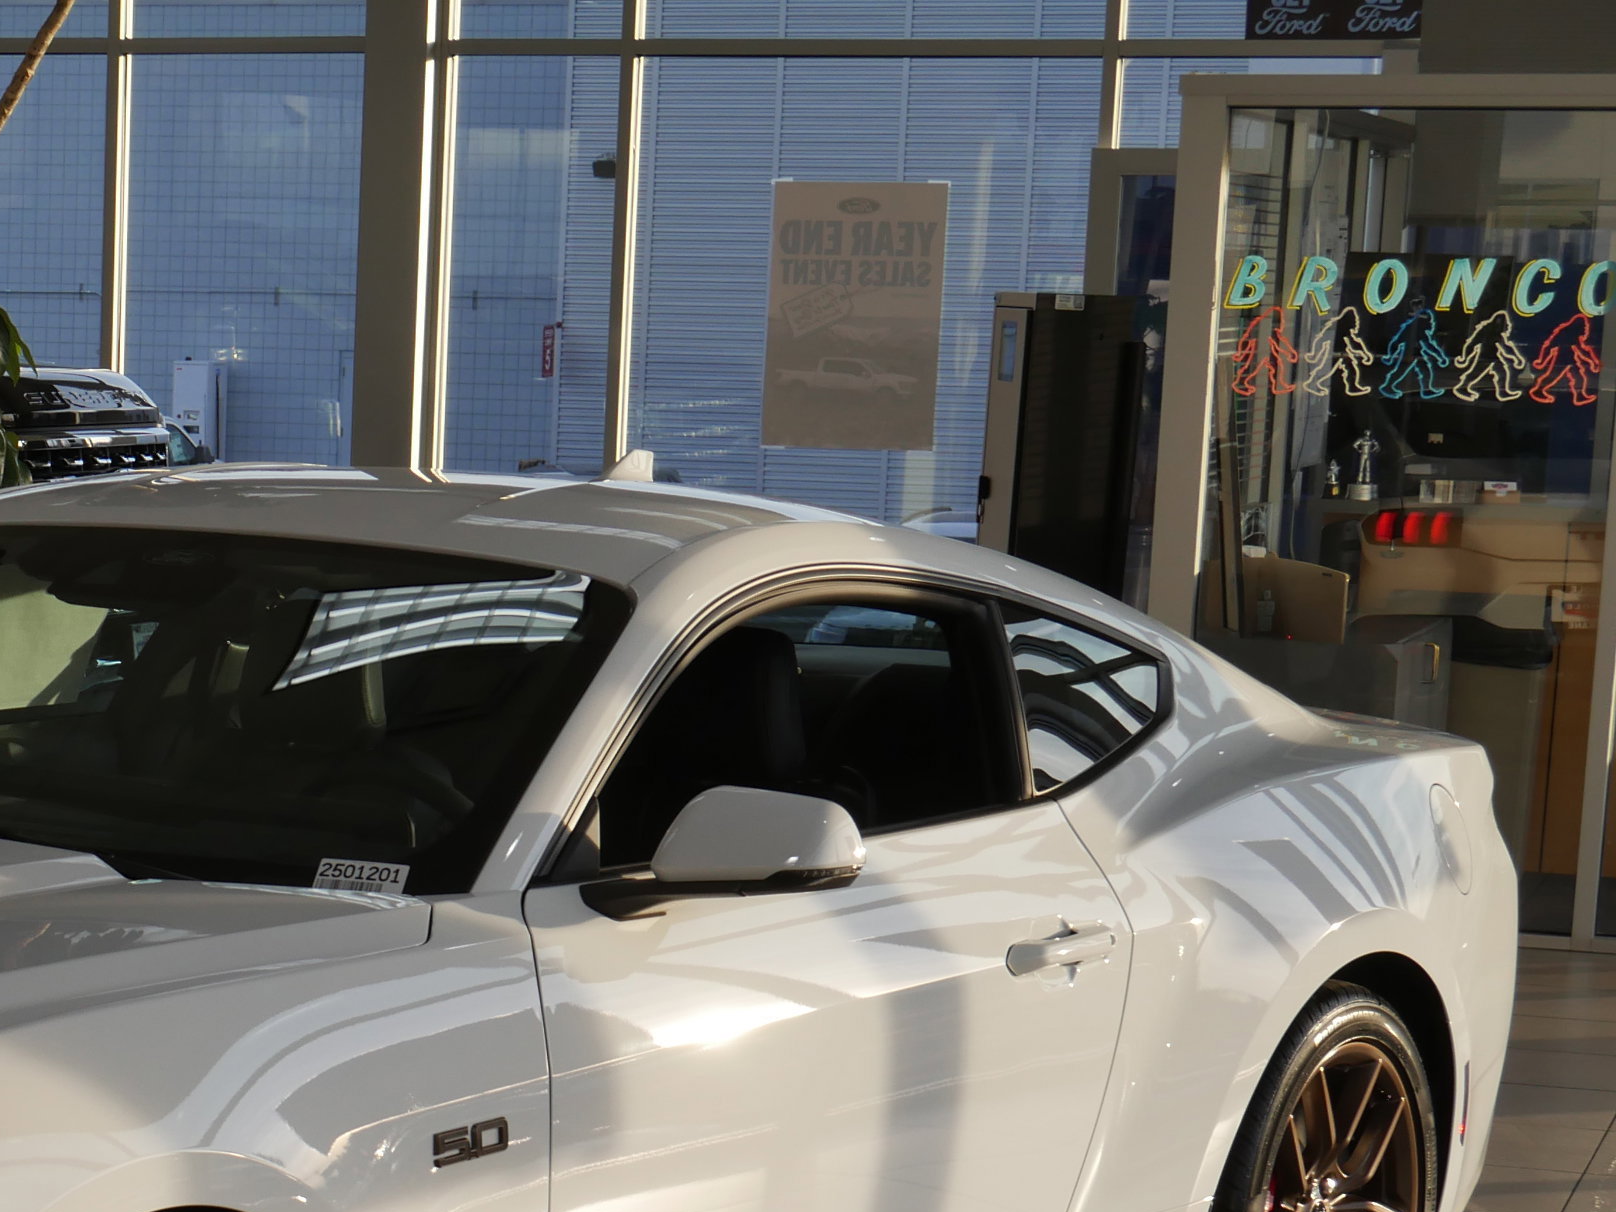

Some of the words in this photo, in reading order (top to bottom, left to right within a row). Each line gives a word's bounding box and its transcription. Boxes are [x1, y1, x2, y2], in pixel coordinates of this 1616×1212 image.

[1255, 8, 1321, 35] Ford
[1347, 4, 1418, 33] Ford
[1224, 254, 1616, 317] BRONCO
[319, 862, 402, 884] 2501201
